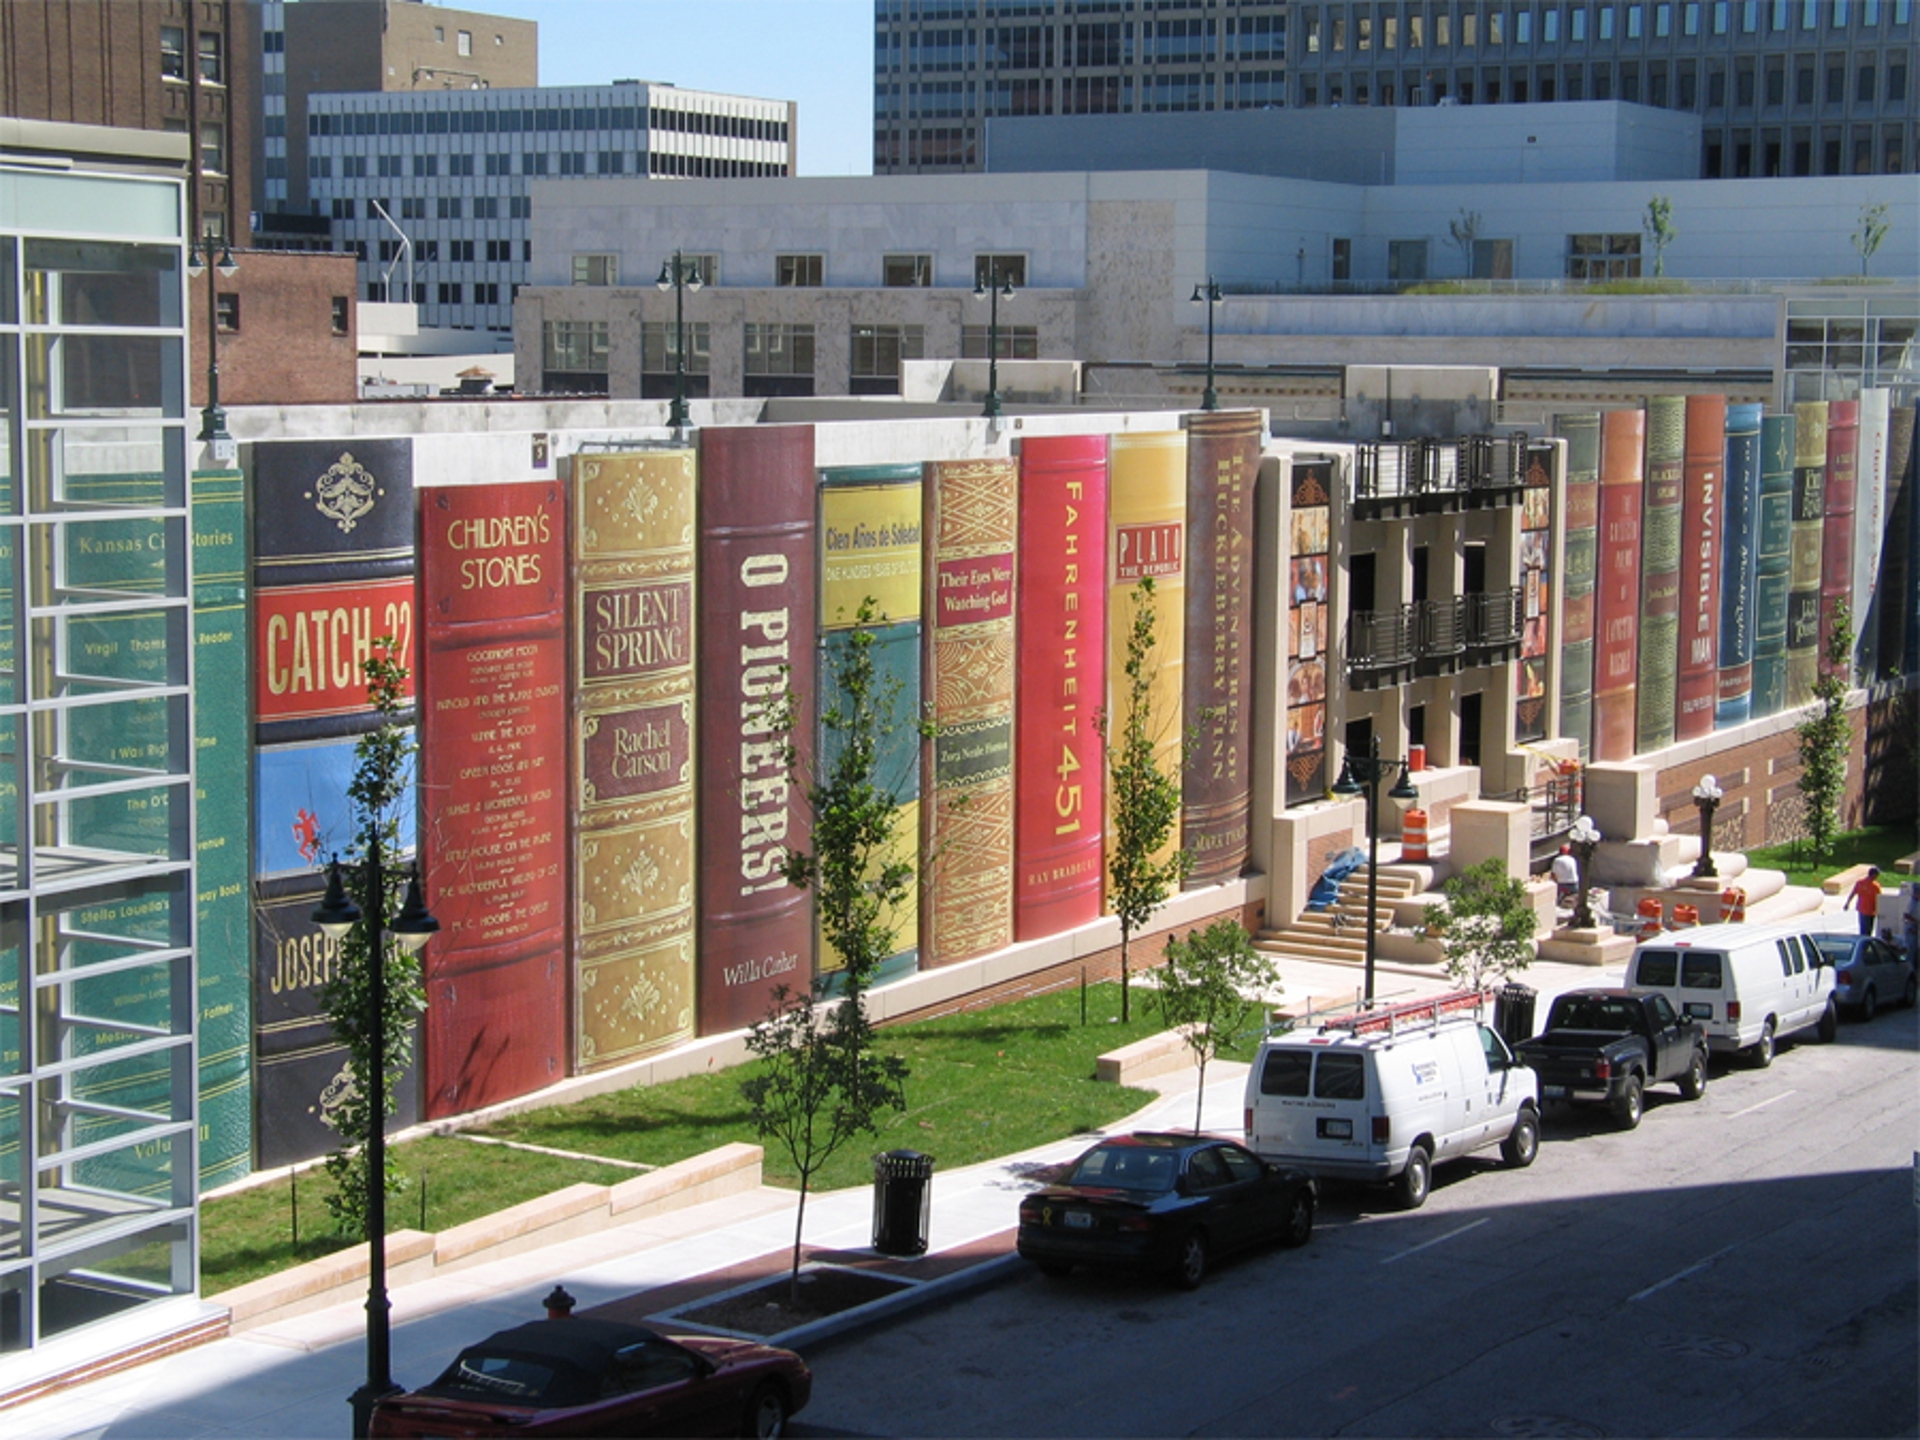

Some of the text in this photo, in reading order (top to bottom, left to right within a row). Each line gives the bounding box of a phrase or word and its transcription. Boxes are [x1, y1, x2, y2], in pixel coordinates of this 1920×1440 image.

[447, 504, 551, 550] CHILDREN'S
[826, 526, 850, 550] Cien
[853, 522, 878, 549] Años
[879, 524, 890, 547] de
[79, 537, 142, 554] Kansas
[1119, 527, 1181, 565] PLATO
[1698, 472, 1714, 633] INVISIBLE
[940, 570, 969, 588] Their
[970, 568, 991, 590] Eyes
[1120, 560, 1180, 577] THE REPUBLIC
[596, 588, 684, 633] SILENT
[944, 588, 1008, 613] Watching God
[1212, 460, 1230, 780] HUCKLEBERRY FINN
[85, 642, 119, 657] Virgil
[199, 631, 233, 646] Reader
[596, 627, 683, 672] SPRING
[1055, 480, 1083, 836] FAHRENHEIT 451
[614, 718, 671, 755] Rachel
[739, 552, 790, 897] O PIONEERS!
[611, 749, 672, 780] Carson
[1027, 870, 1049, 887] RAY
[80, 908, 117, 925] Stella
[120, 898, 170, 919] Louella's
[219, 882, 242, 898] Book
[722, 958, 761, 988] Willa
[203, 1002, 234, 1020] Father
[133, 1137, 172, 1160] Volu
